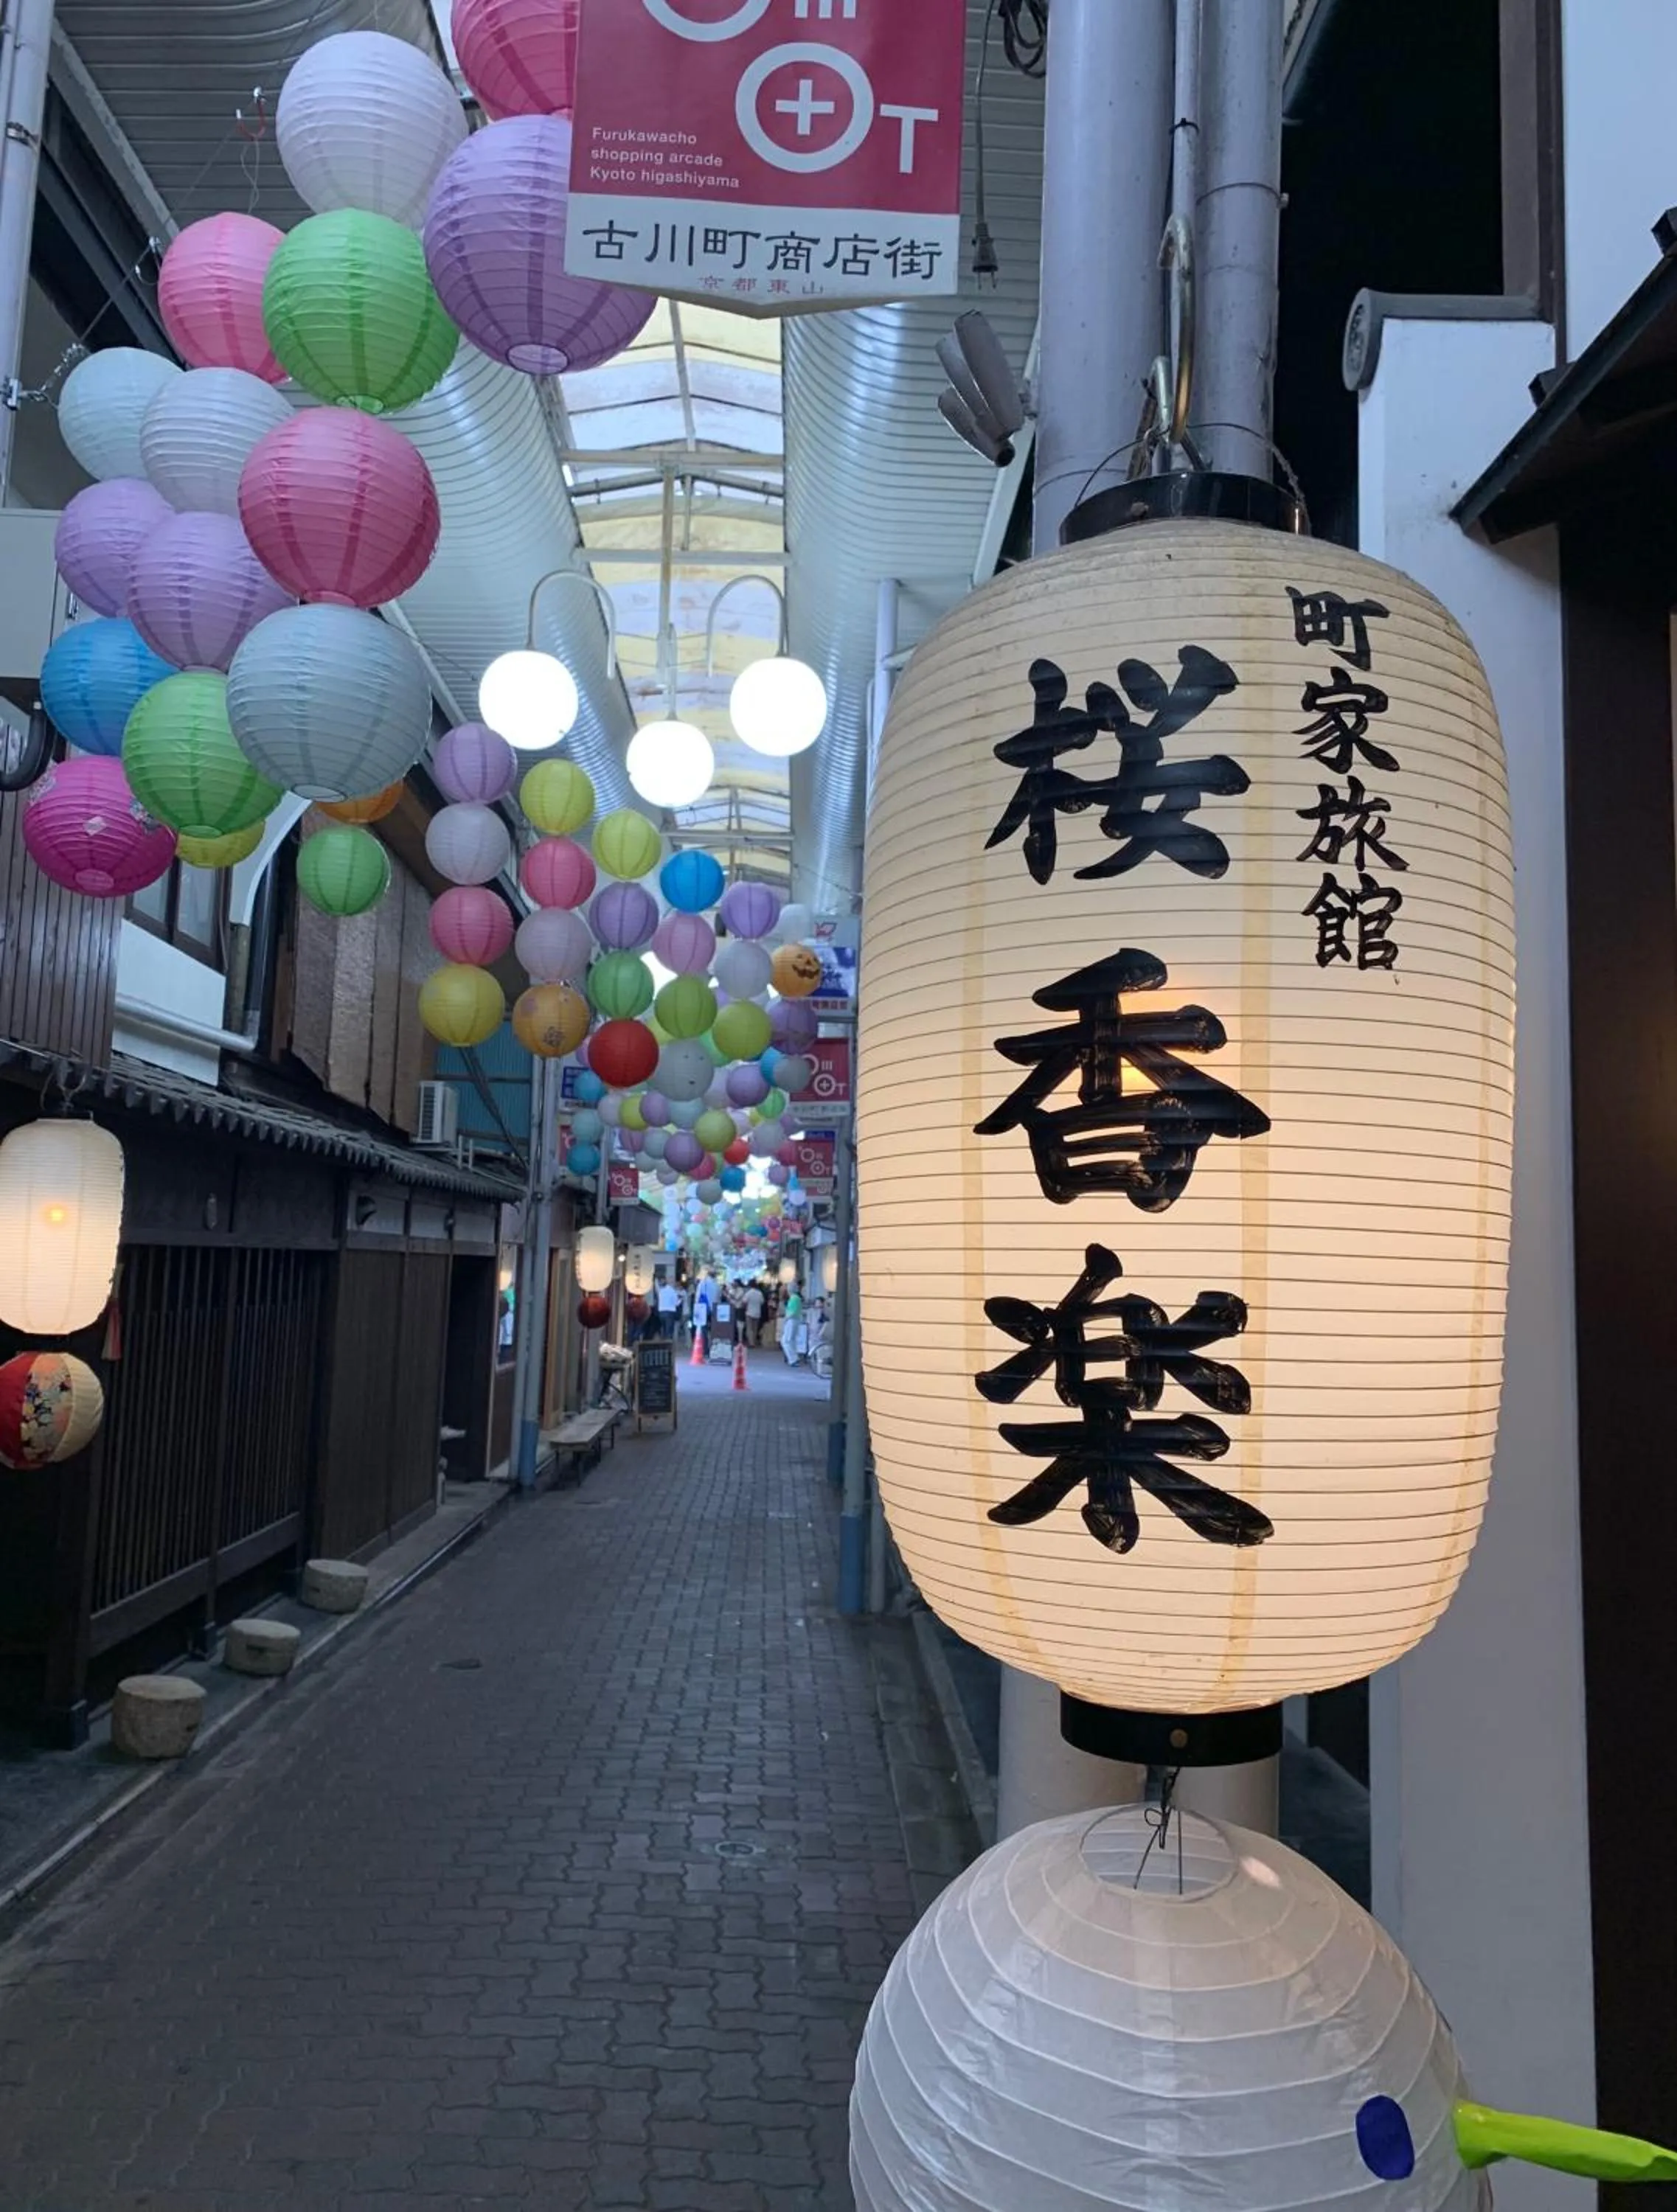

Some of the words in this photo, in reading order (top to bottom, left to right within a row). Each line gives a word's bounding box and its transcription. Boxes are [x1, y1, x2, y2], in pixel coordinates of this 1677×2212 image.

[592, 127, 698, 145] Furukawacho
[591, 147, 664, 164] shopping
[669, 152, 723, 167] arcade
[590, 167, 636, 182] Kyoto
[641, 168, 740, 188] higashiyama
[583, 220, 942, 280] 古川町商店街
[698, 275, 824, 294] 京都東山
[1285, 585, 1409, 971] 町家旅館
[972, 644, 1275, 1555] 桜香楽
